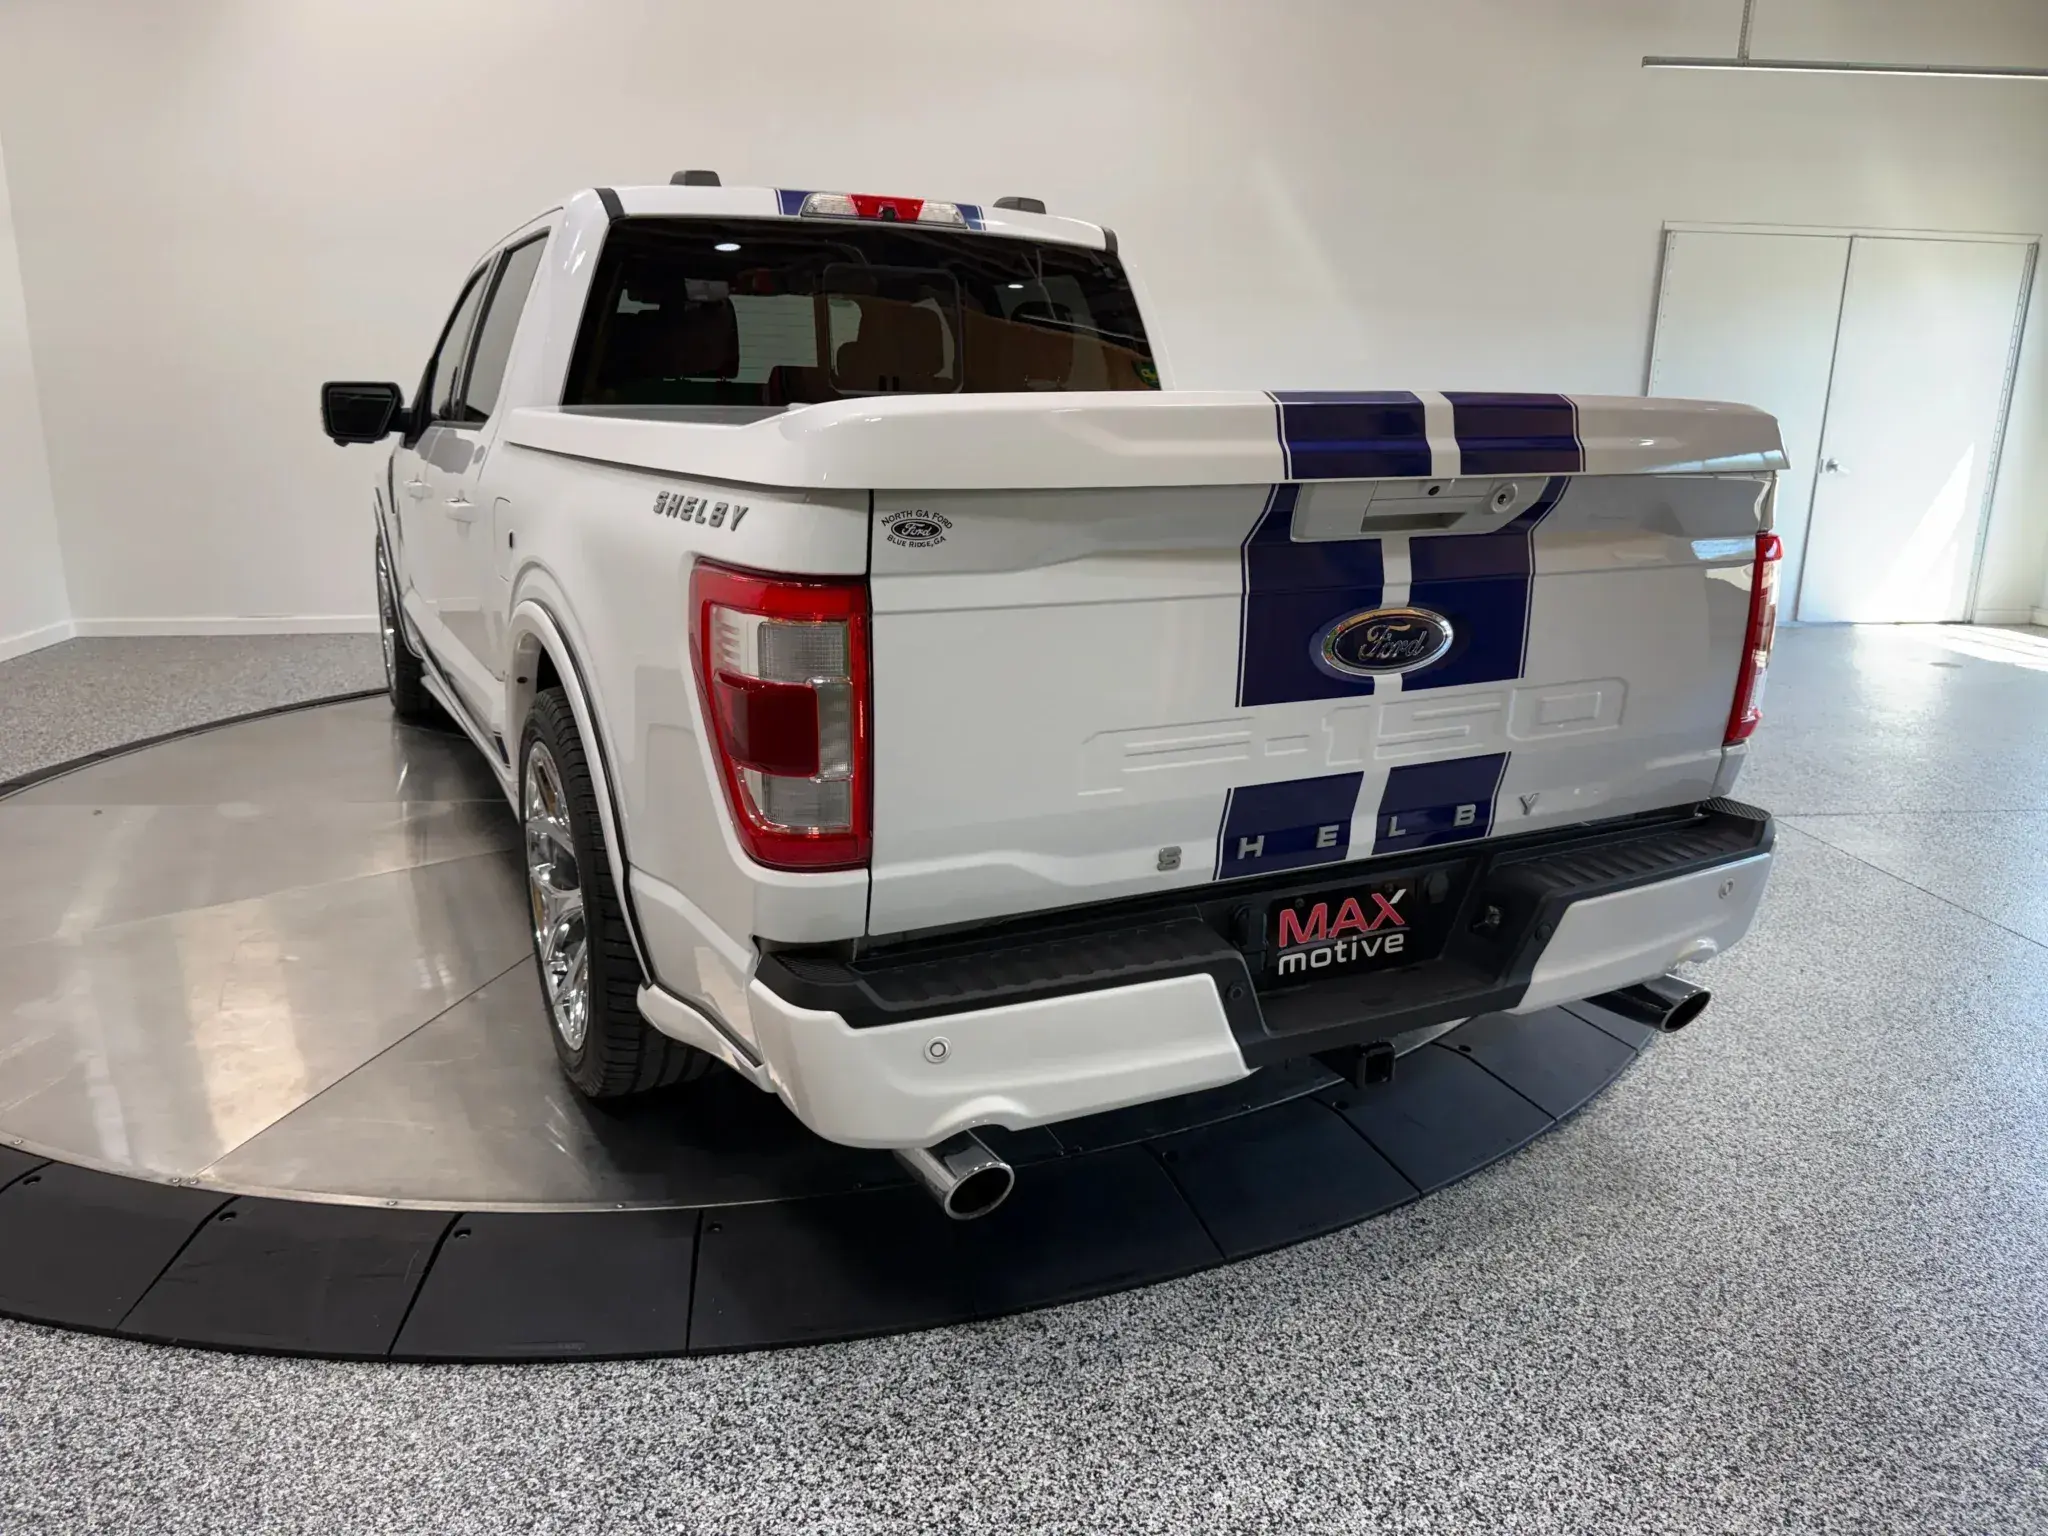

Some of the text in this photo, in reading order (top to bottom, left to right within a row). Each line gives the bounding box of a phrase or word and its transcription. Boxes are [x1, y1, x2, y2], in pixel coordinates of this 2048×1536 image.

[652, 490, 749, 532] SHELBY
[881, 509, 953, 529] NORTH GA FORD
[901, 522, 933, 536] Ford
[887, 534, 907, 547] BLUE
[1358, 622, 1429, 663] Ford
[1077, 677, 1629, 797] F-150
[1156, 792, 1540, 872] SHELBY
[1278, 888, 1407, 948] MAX
[1278, 933, 1405, 976] motive
